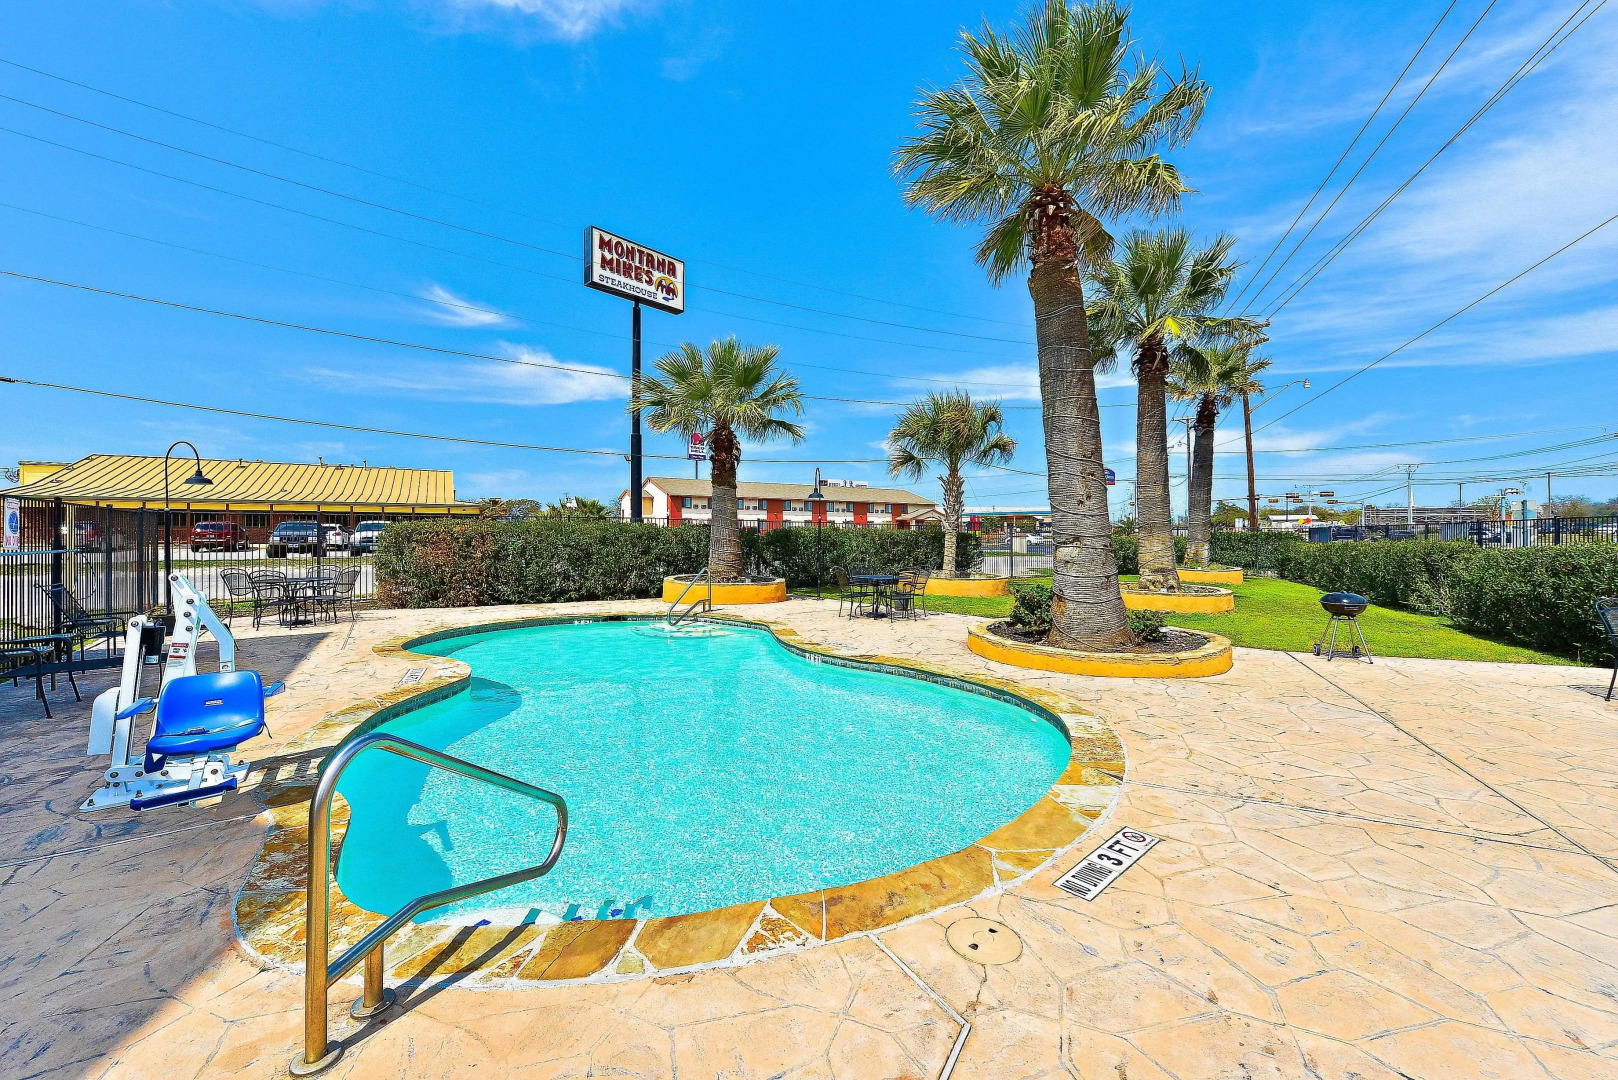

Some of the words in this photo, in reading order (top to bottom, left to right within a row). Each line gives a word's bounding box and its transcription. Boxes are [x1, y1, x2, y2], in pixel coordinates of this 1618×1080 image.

[599, 233, 677, 279] MONTANA
[601, 252, 654, 286] MIKE'S
[599, 274, 657, 300] STEAKHOUSE
[1097, 853, 1124, 866] 3
[1106, 839, 1140, 858] FT
[1060, 879, 1092, 897] NO
[1071, 862, 1113, 888] DIVING
